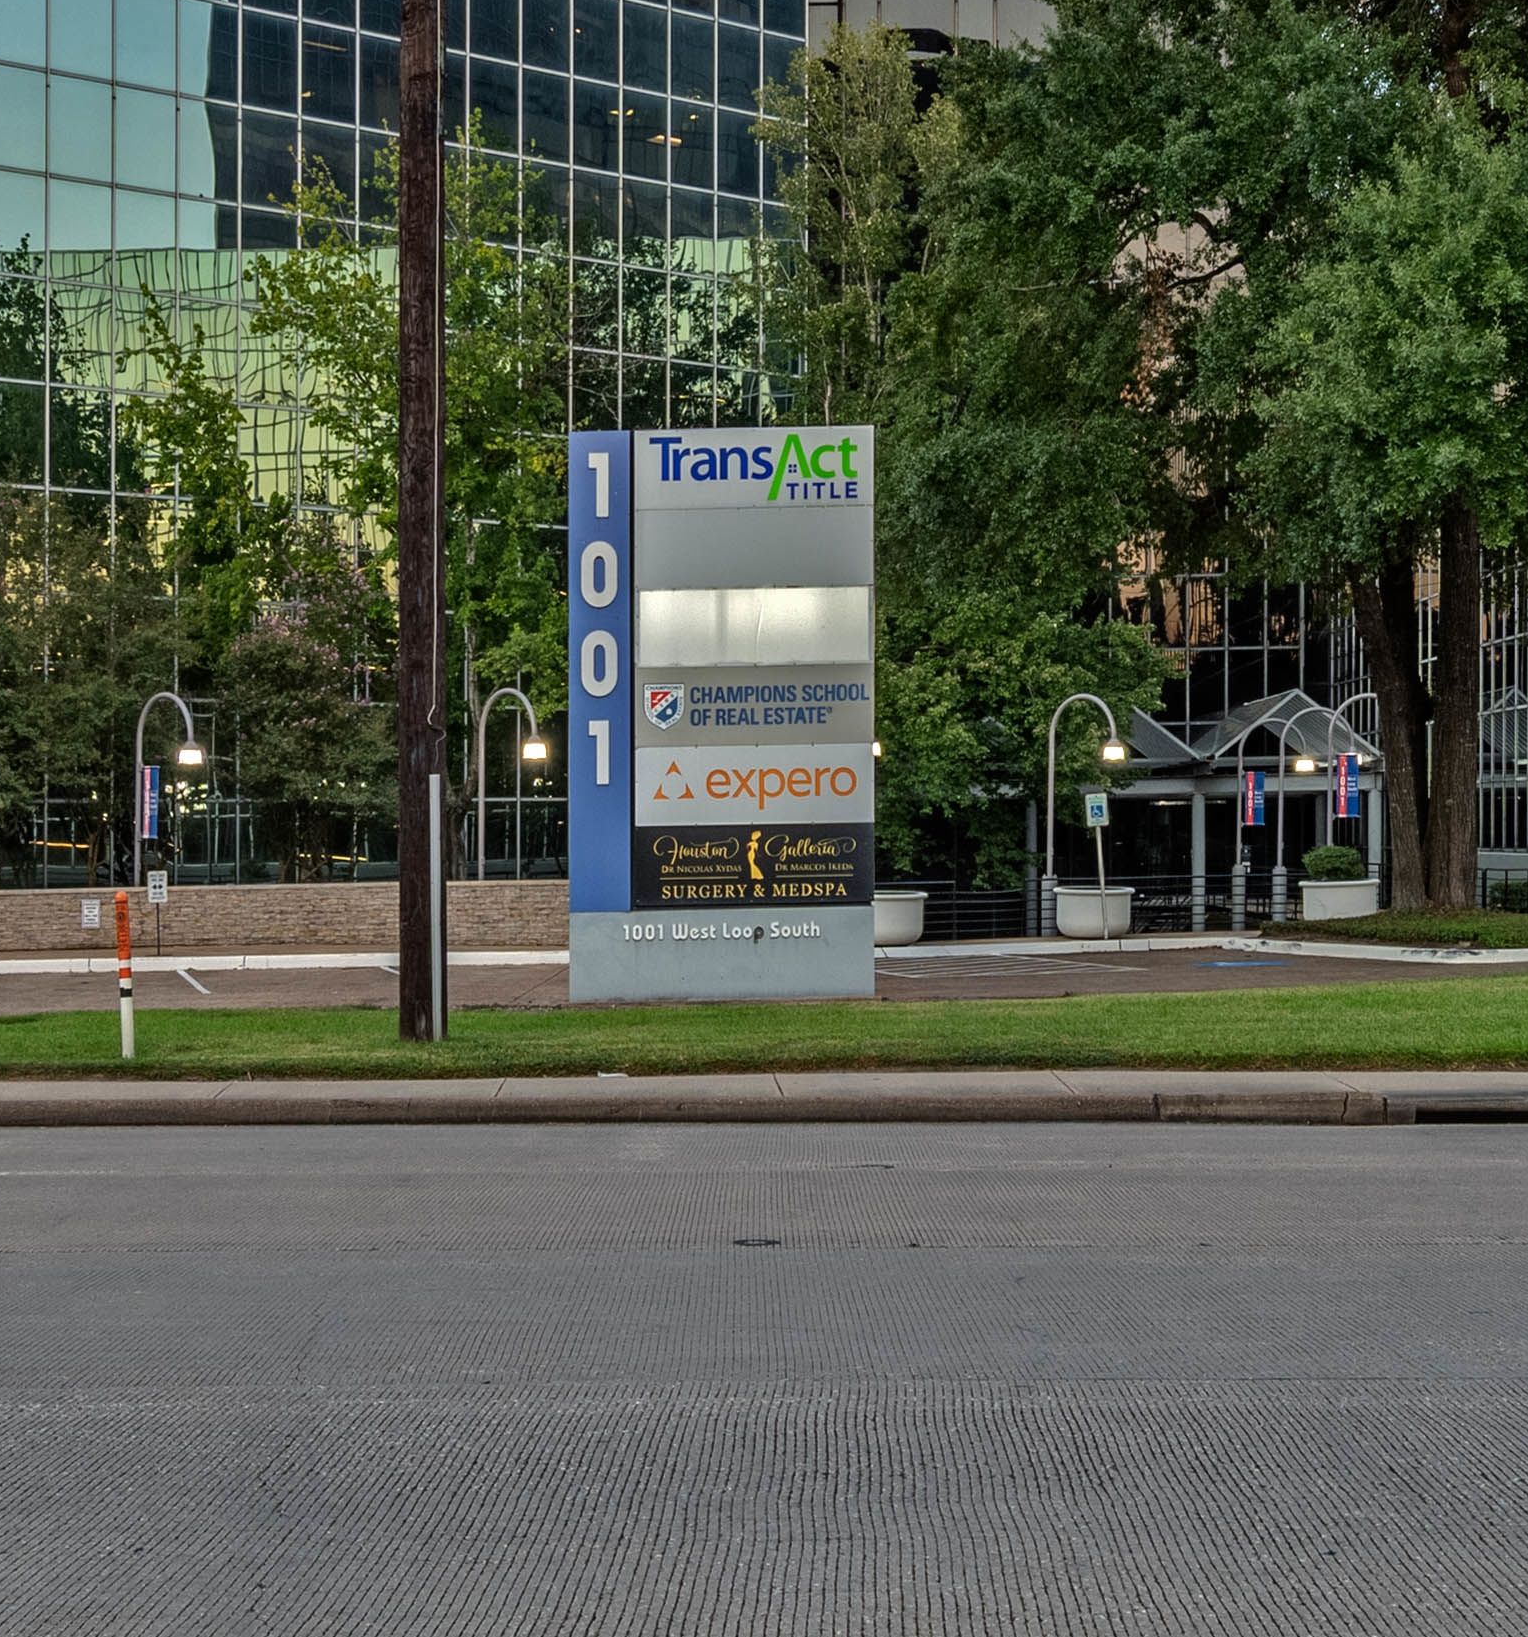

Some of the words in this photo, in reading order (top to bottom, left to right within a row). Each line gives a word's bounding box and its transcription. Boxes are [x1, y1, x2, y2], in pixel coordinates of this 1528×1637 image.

[649, 433, 858, 501] TransAct
[786, 481, 858, 500] TITLE
[580, 452, 619, 786] 1001
[690, 685, 798, 705] CHAMPIONS
[802, 683, 870, 702] SCHOOL
[690, 708, 711, 727] OF
[715, 707, 760, 726] REAL
[705, 766, 858, 811] expero
[1339, 766, 1347, 806] 1001
[653, 835, 740, 864] Houston
[764, 834, 857, 862] Galleria
[661, 883, 748, 900] SURGERY
[753, 884, 766, 898] &
[772, 882, 848, 898] MEDSPA
[623, 924, 665, 941] 1001
[672, 923, 717, 940] West
[722, 922, 766, 945] Loop
[770, 920, 821, 939] South
